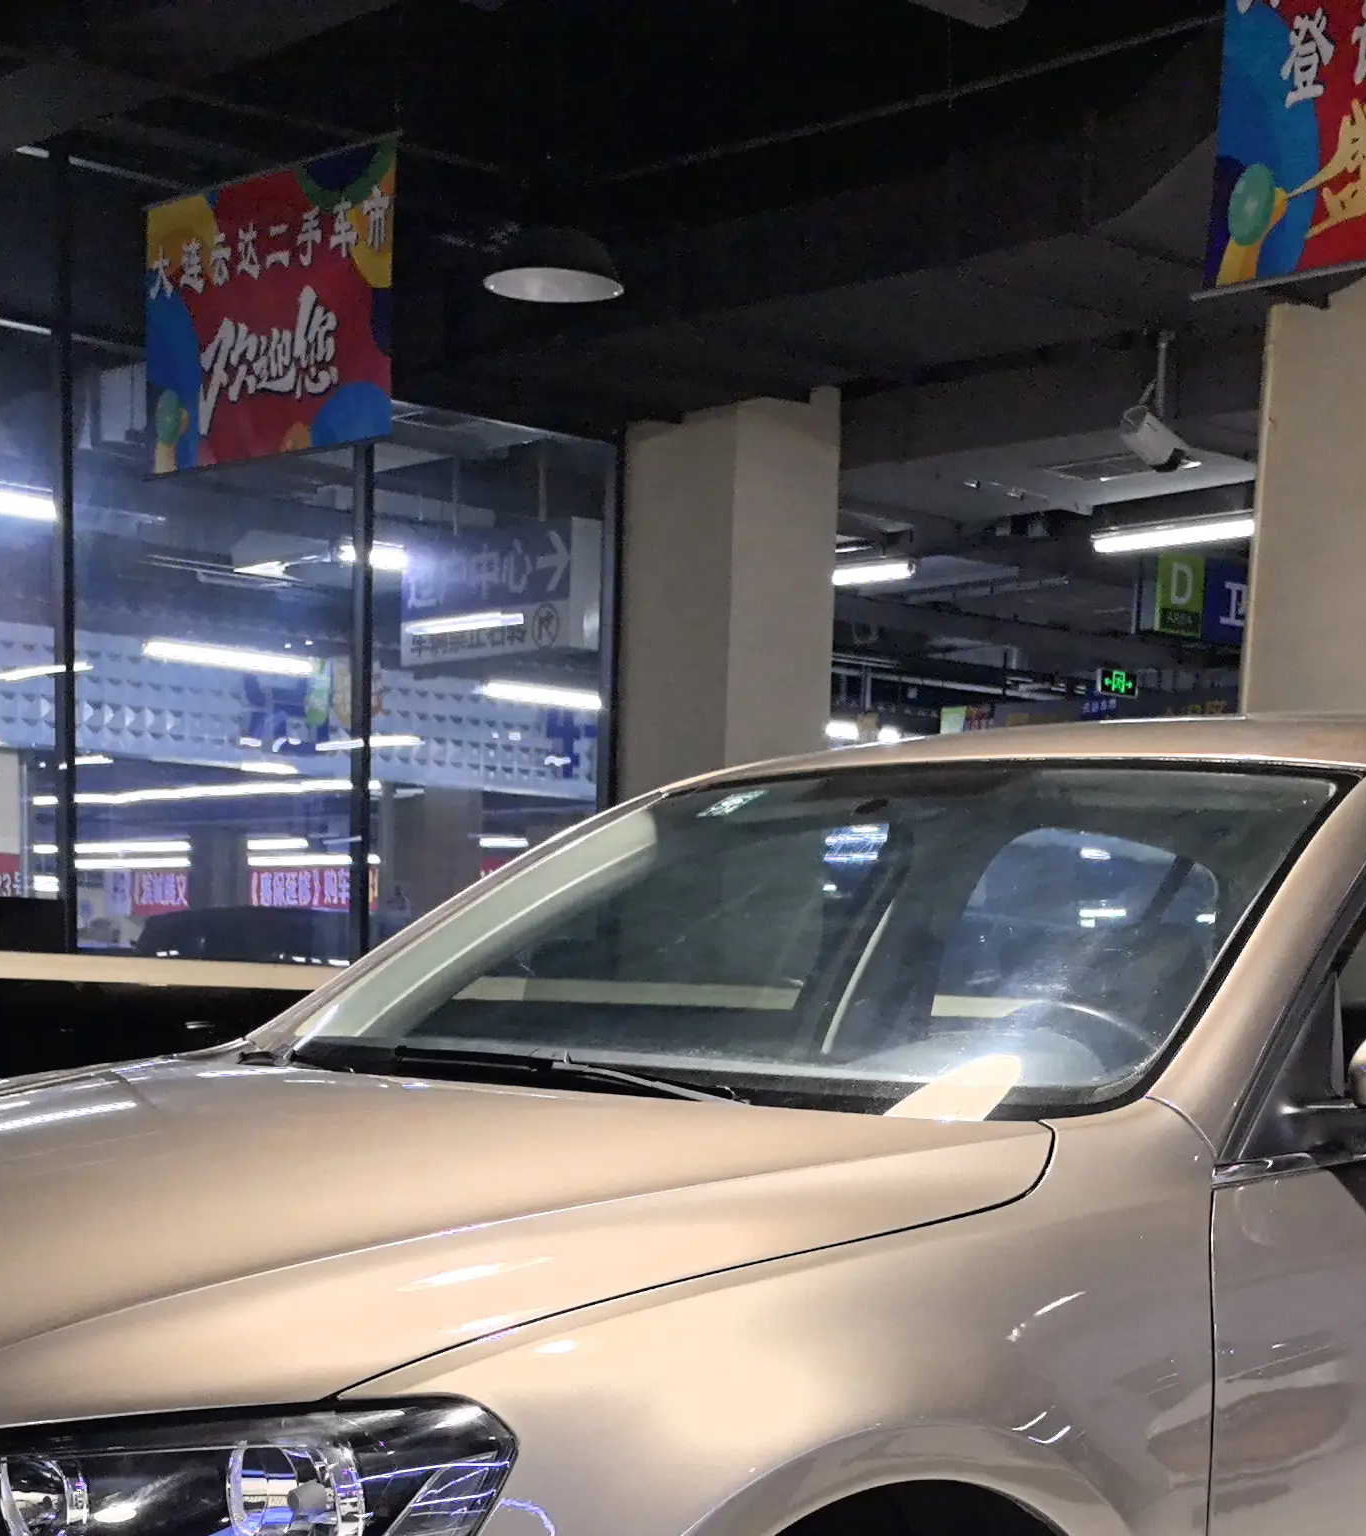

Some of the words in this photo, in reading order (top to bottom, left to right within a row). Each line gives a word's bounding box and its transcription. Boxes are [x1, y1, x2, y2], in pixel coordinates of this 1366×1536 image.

[198, 285, 338, 435] 欢迎您
[1170, 562, 1194, 605] D
